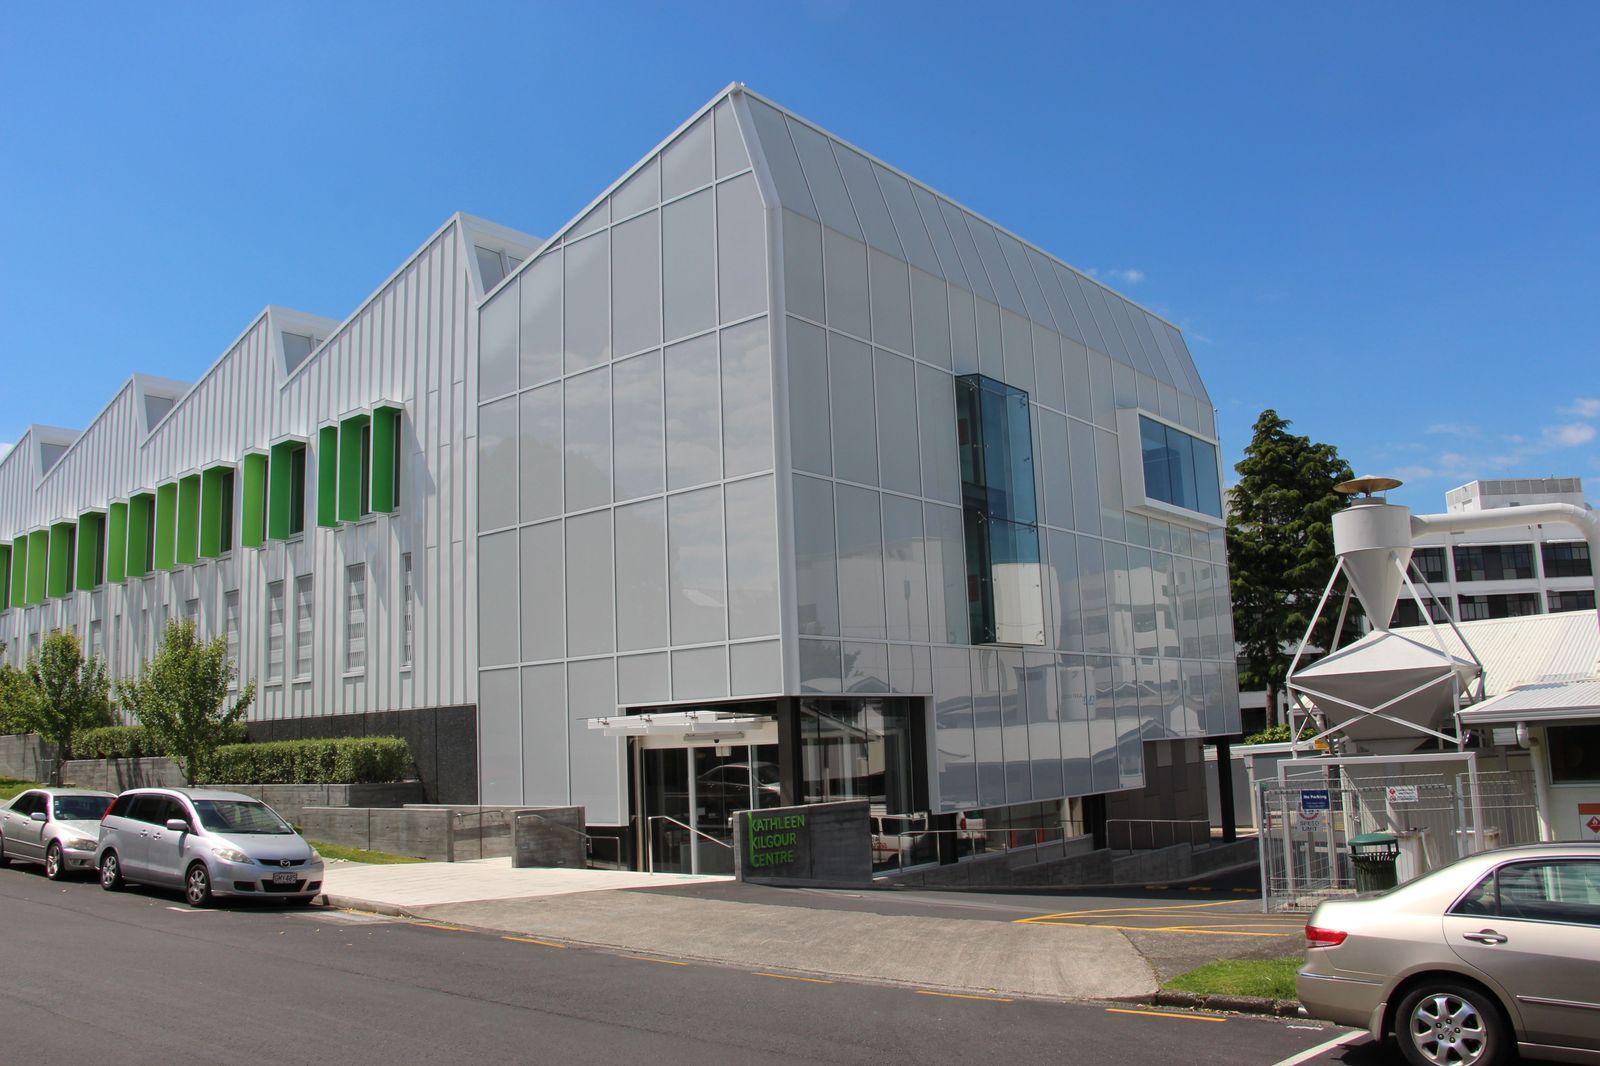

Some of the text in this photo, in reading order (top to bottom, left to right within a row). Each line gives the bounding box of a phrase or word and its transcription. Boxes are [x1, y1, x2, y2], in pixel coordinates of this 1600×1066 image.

[750, 815, 805, 831] KATHLEEN
[750, 832, 797, 849] KILGOUR
[752, 851, 794, 868] CENTRE
